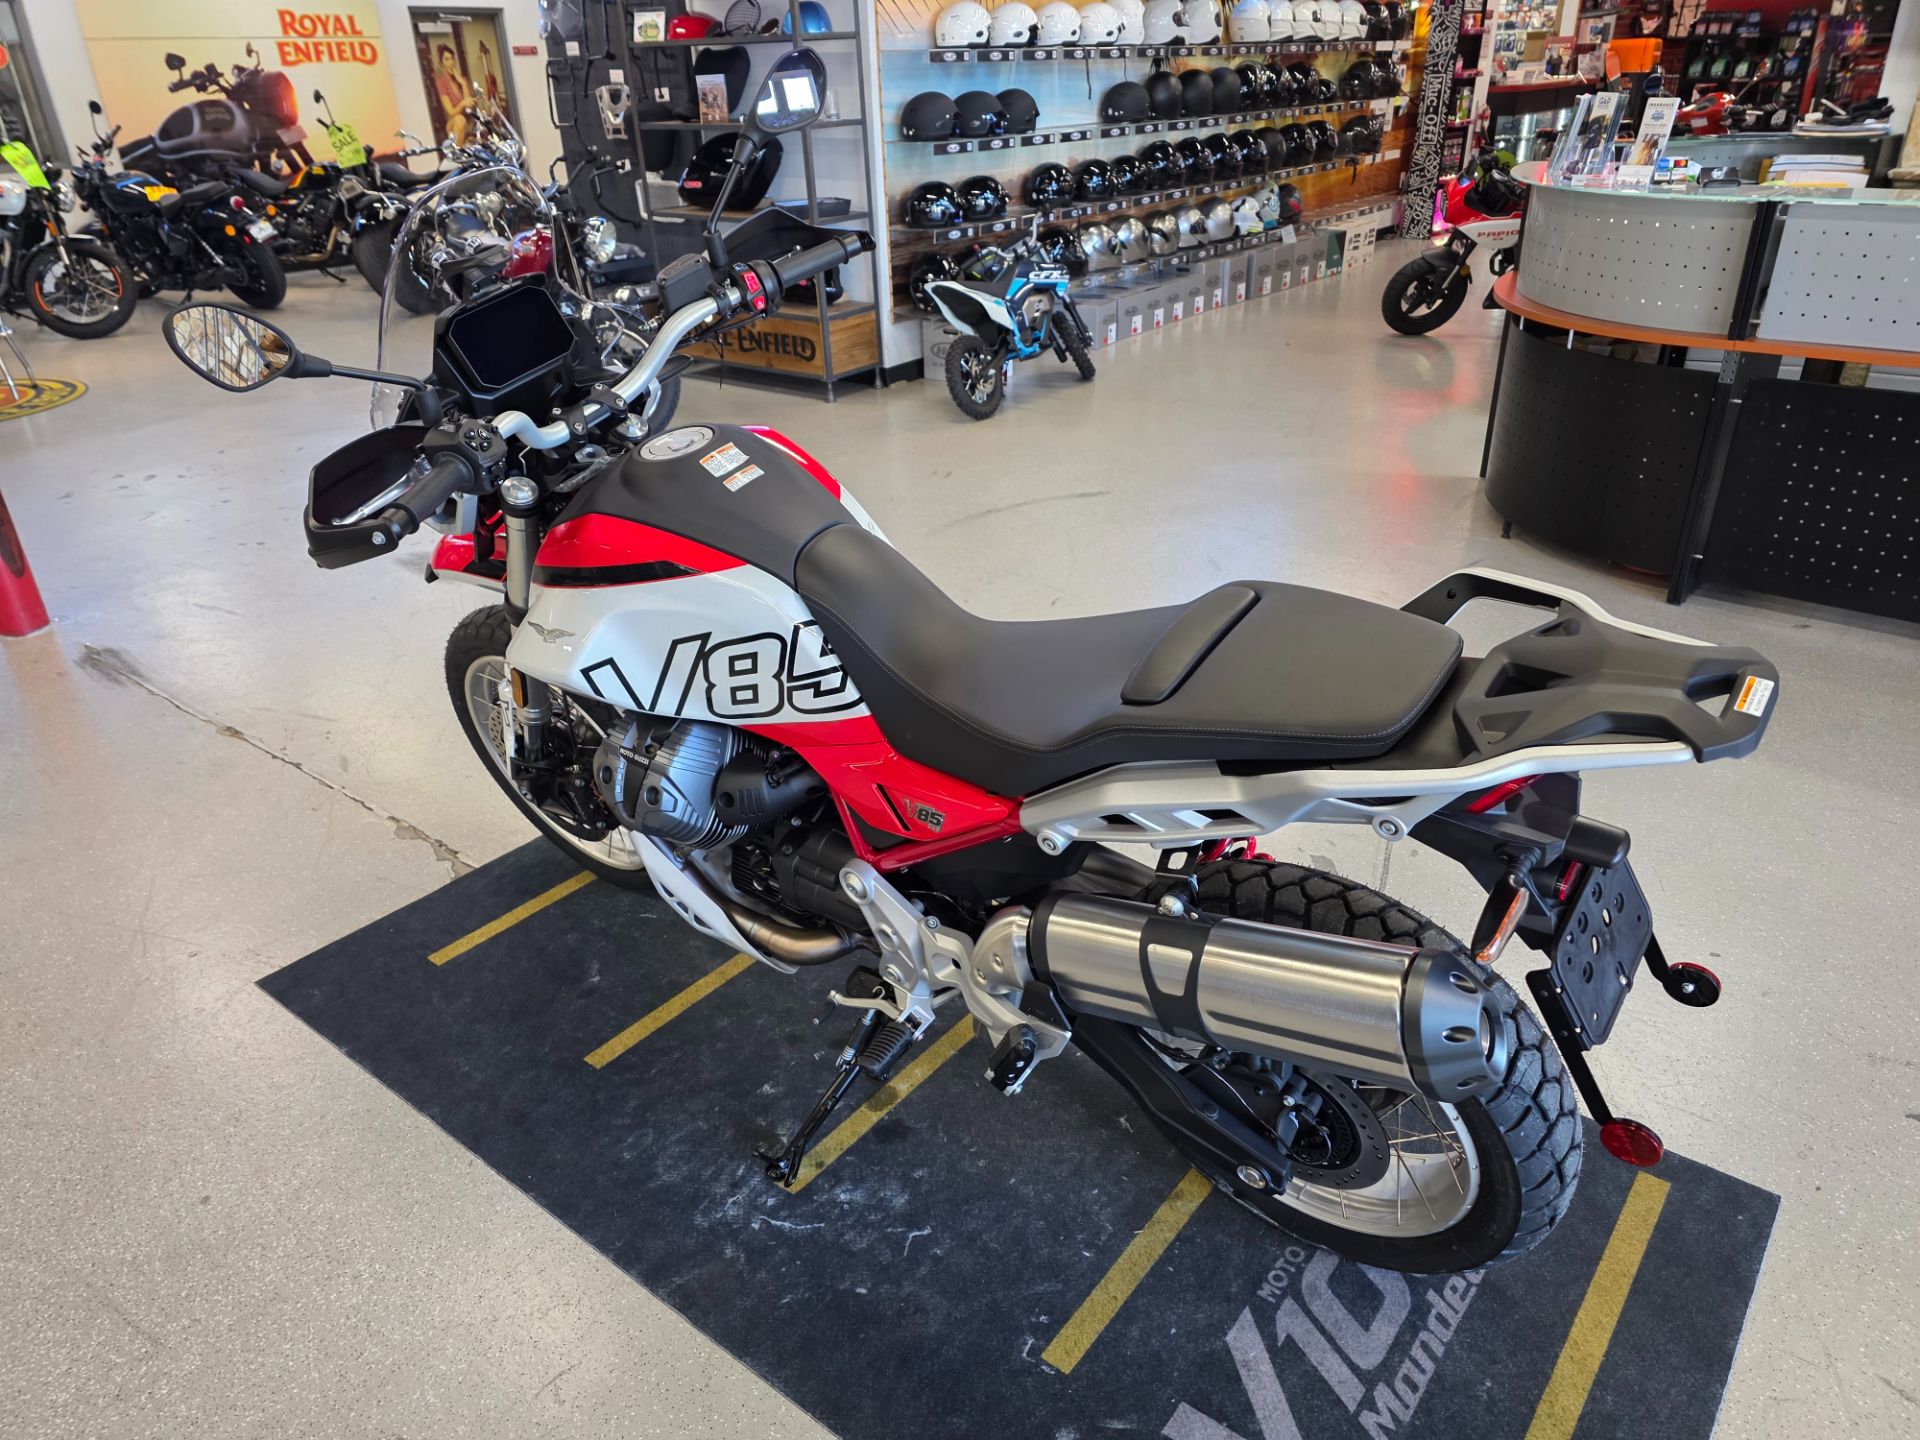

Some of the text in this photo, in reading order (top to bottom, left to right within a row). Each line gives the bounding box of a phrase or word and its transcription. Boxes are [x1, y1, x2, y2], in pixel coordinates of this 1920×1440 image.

[277, 9, 363, 38] ROYAL
[275, 41, 378, 67] ENFIELD
[1422, 77, 1443, 141] Muc-Off
[332, 130, 358, 152] SALE
[737, 326, 816, 362] ENFIELD
[580, 619, 867, 719] V85
[620, 748, 650, 765] MOTO GUZZI
[1256, 1246, 1305, 1302] MOTO
[1161, 1249, 1411, 1440] V10
